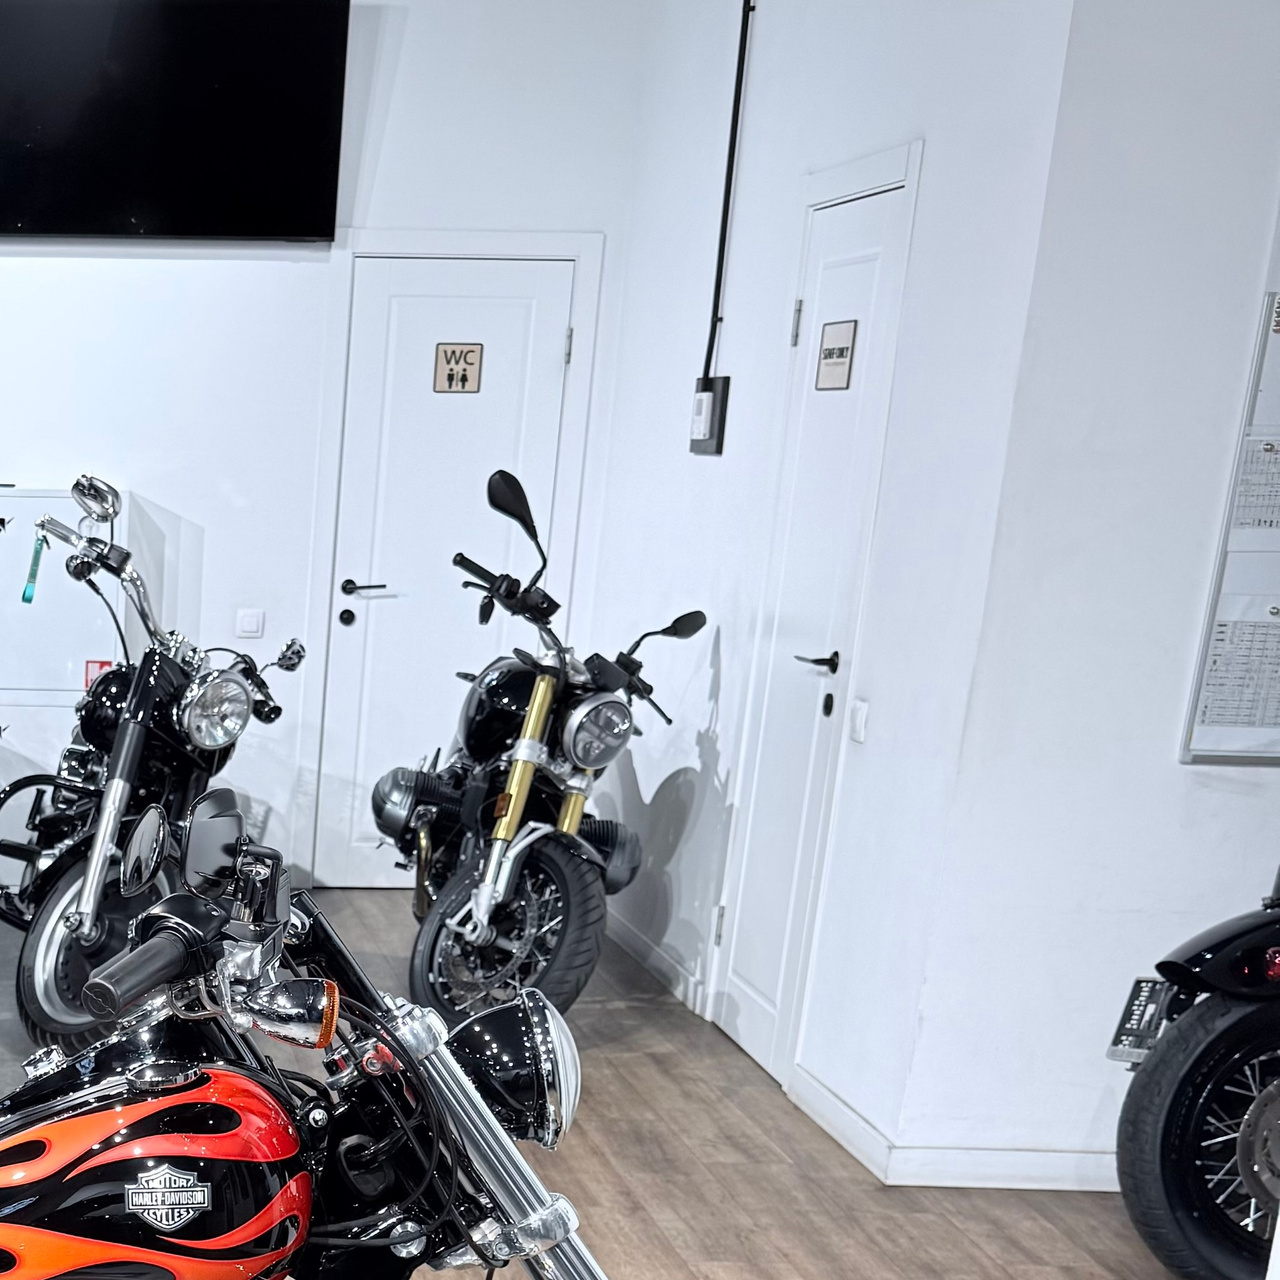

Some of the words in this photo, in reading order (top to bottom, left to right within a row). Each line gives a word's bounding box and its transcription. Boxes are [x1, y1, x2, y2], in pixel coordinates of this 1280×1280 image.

[443, 350, 475, 366] WC
[148, 1174, 187, 1188] MOTOR
[132, 1191, 204, 1206] HARLEY-DAVIDSON
[149, 1208, 188, 1224] CYCLES
